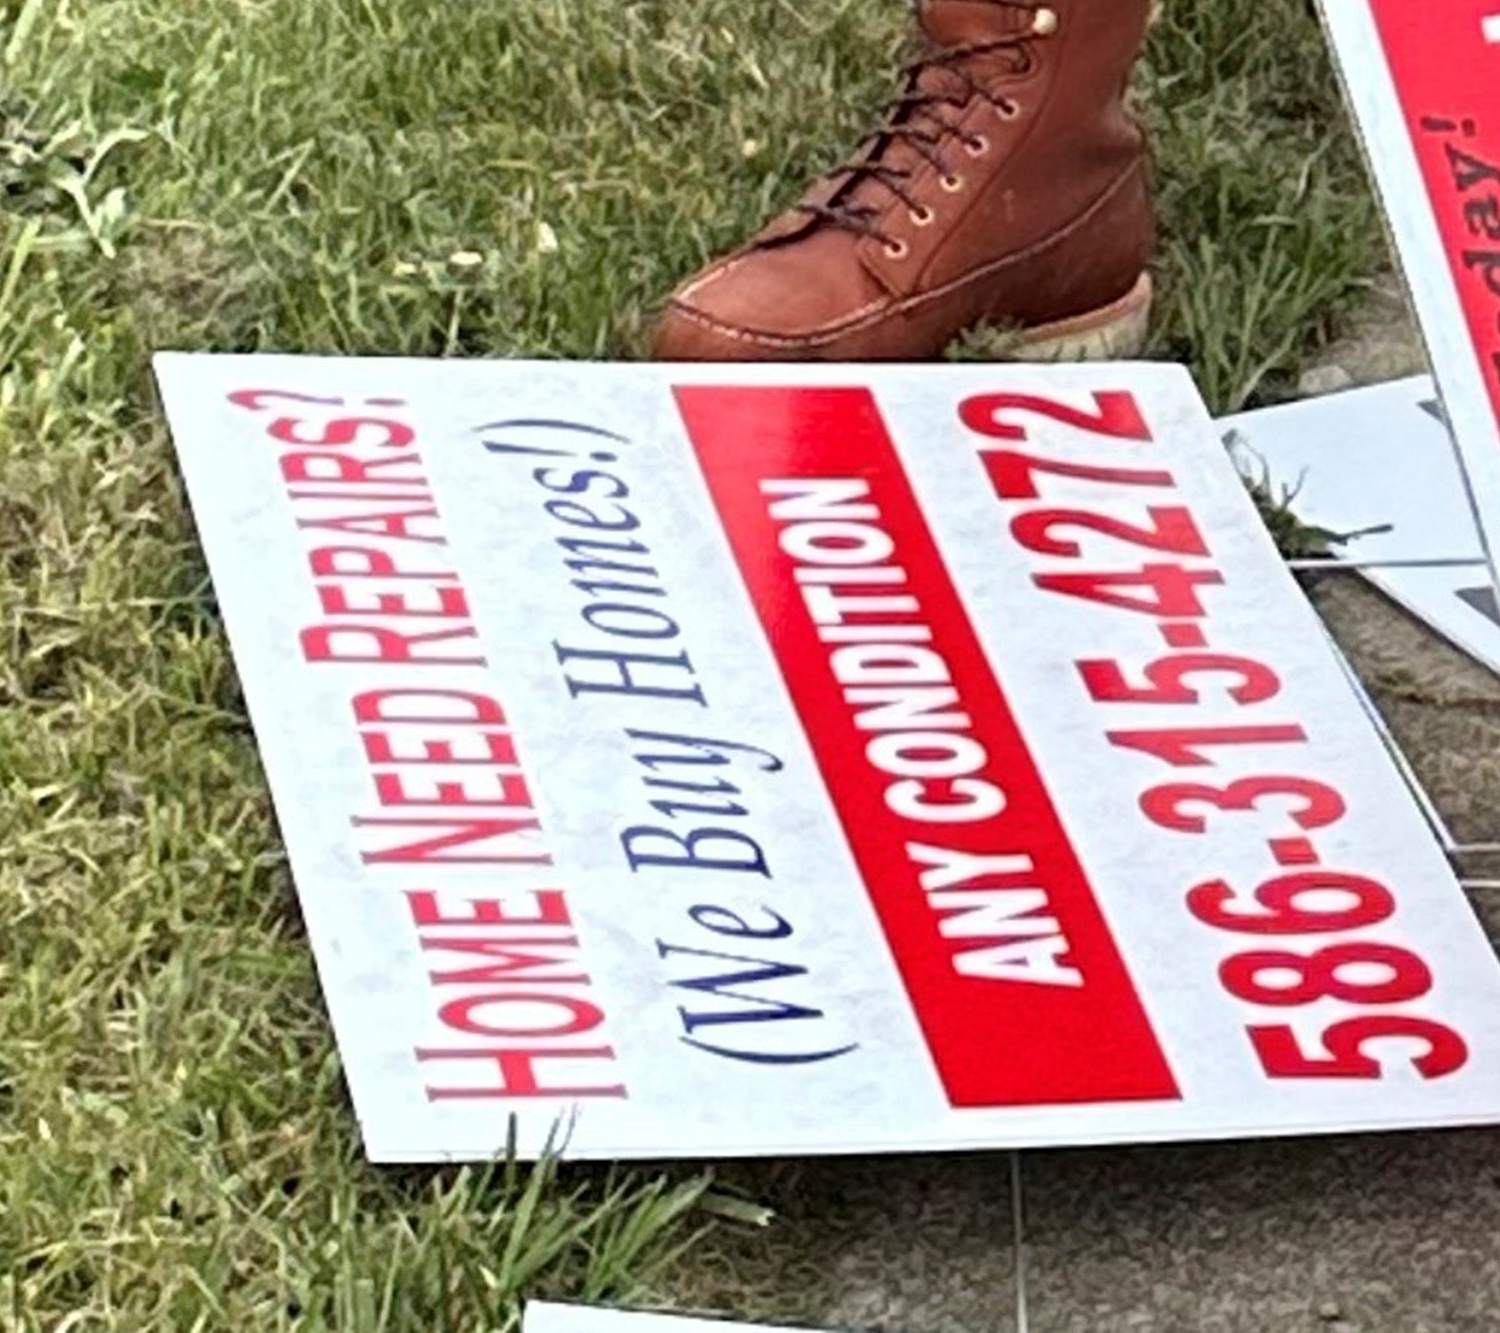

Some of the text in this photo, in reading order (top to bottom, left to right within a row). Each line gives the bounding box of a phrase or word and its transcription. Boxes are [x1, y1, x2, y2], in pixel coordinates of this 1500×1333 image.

[226, 387, 629, 1102] HOME NEED REPAIRS?
[473, 417, 861, 1067] (We Buy Homes!)
[759, 476, 1086, 989] ANY CONDITION
[956, 388, 1470, 1081] 586-315-4272
